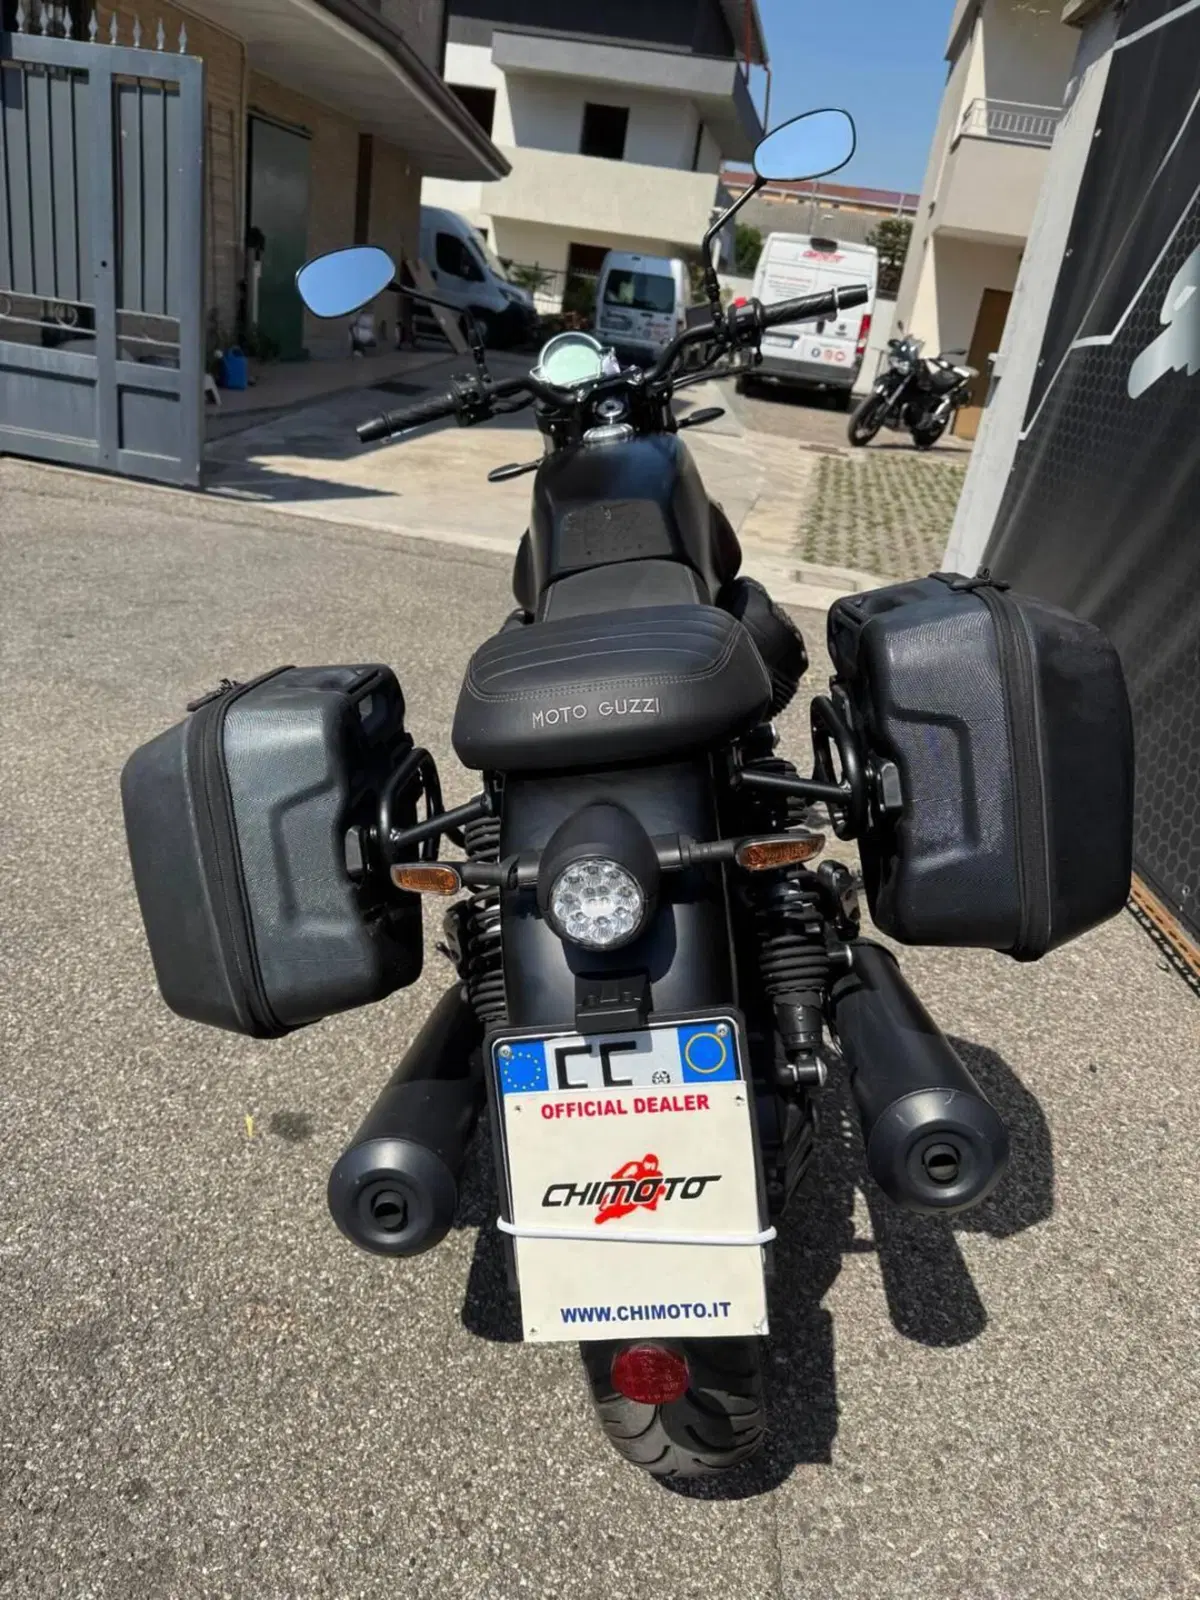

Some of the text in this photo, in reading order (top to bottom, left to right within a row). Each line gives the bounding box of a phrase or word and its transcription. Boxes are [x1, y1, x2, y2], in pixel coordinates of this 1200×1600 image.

[531, 697, 660, 729] MOTO GUZZI
[541, 1094, 710, 1119] OFFICIAL DEALER
[541, 1174, 722, 1207] CHIMOTO
[560, 1301, 732, 1323] WWW.CHIMOTO.IT
